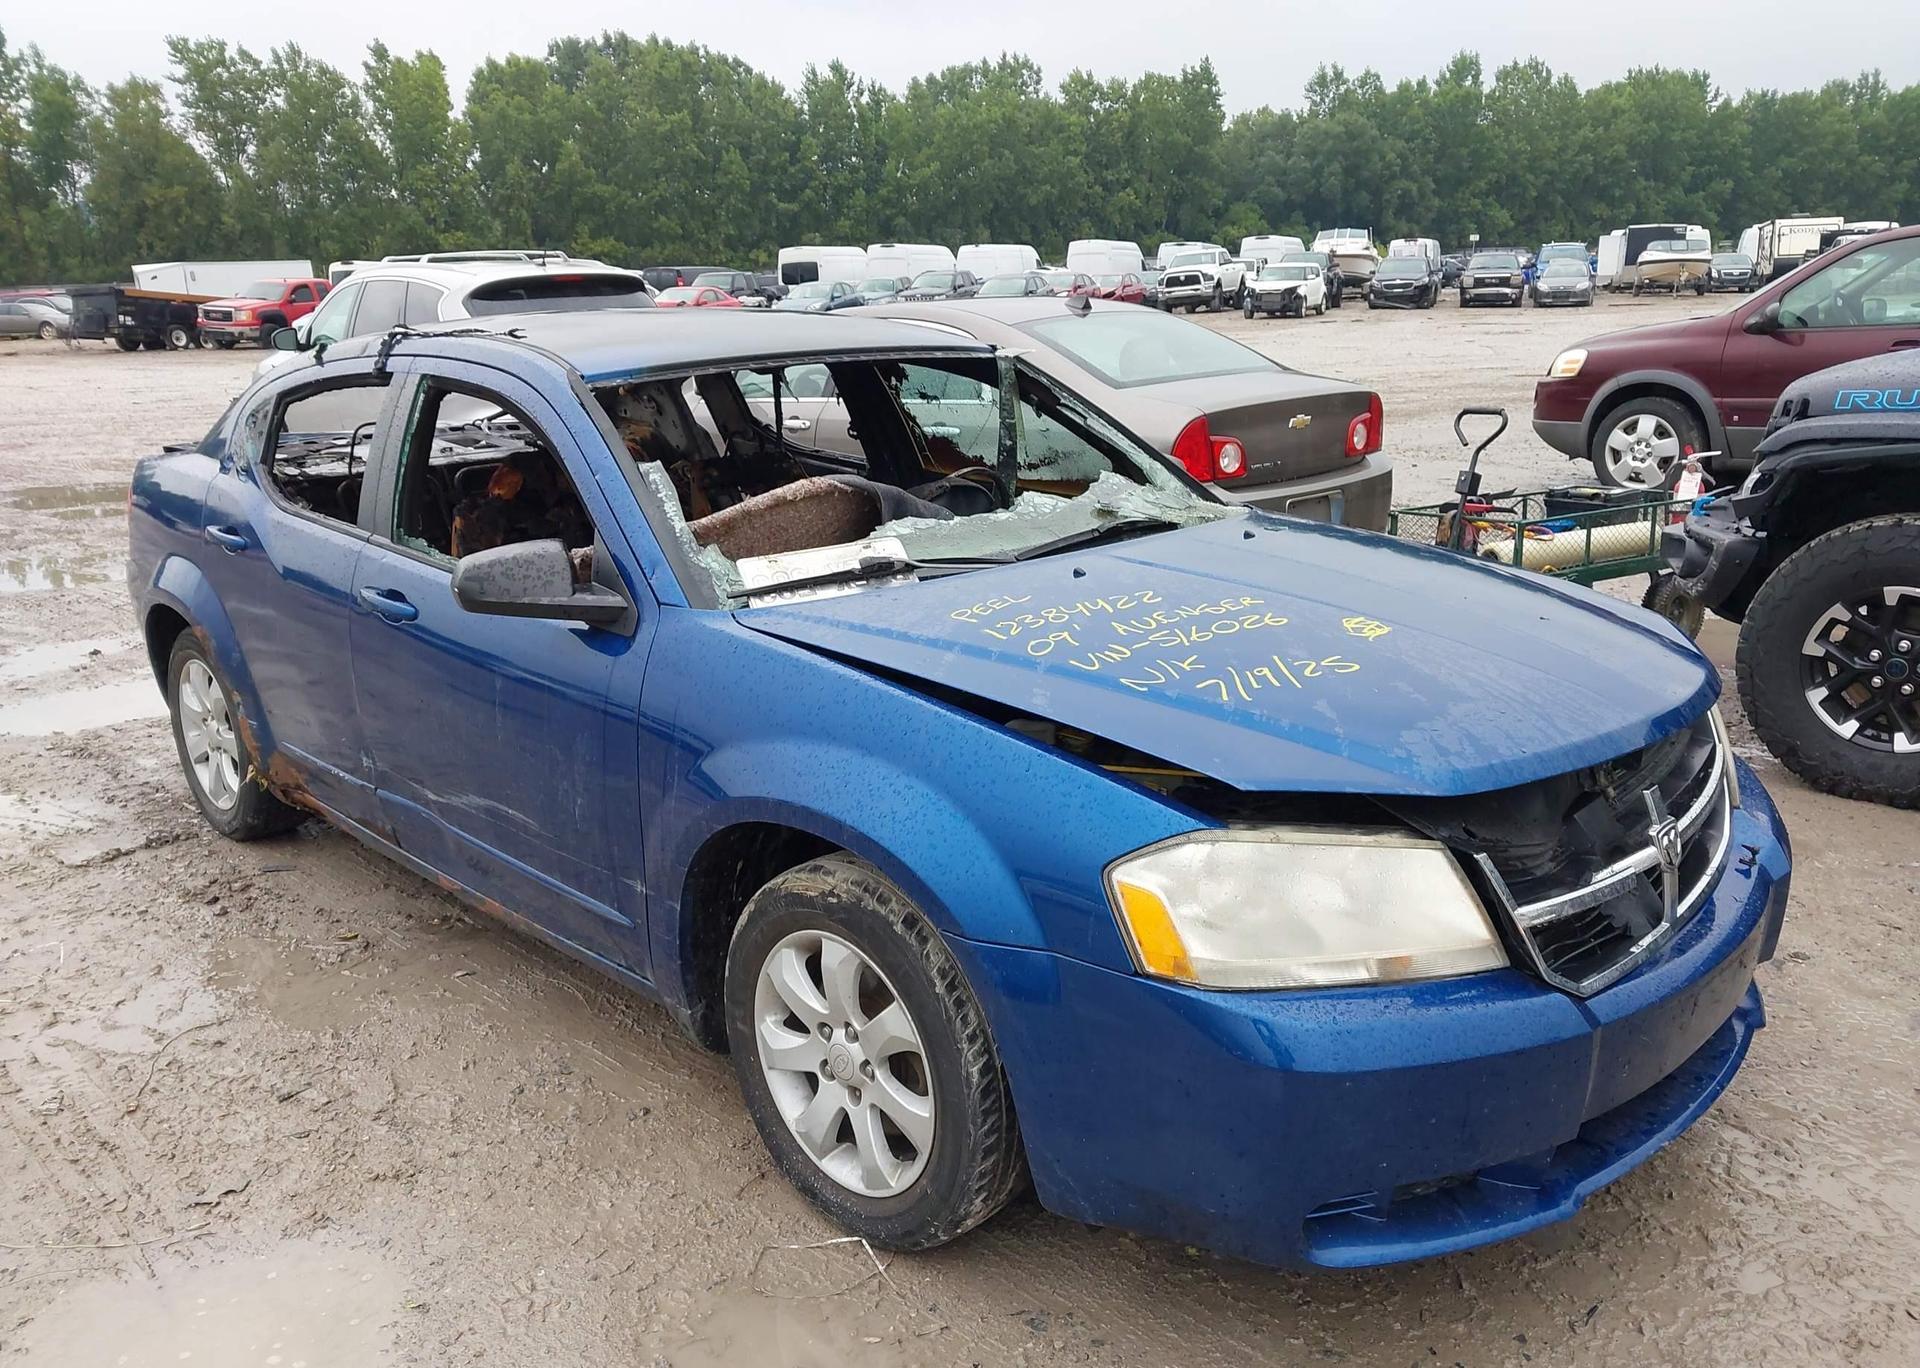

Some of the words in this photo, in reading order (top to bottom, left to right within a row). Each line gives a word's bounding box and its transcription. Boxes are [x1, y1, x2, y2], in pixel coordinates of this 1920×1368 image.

[950, 593, 1032, 623] PEEL
[982, 590, 1163, 641] 12384422
[1119, 654, 1206, 693] N/K
[1196, 655, 1362, 703] 7/19/25
